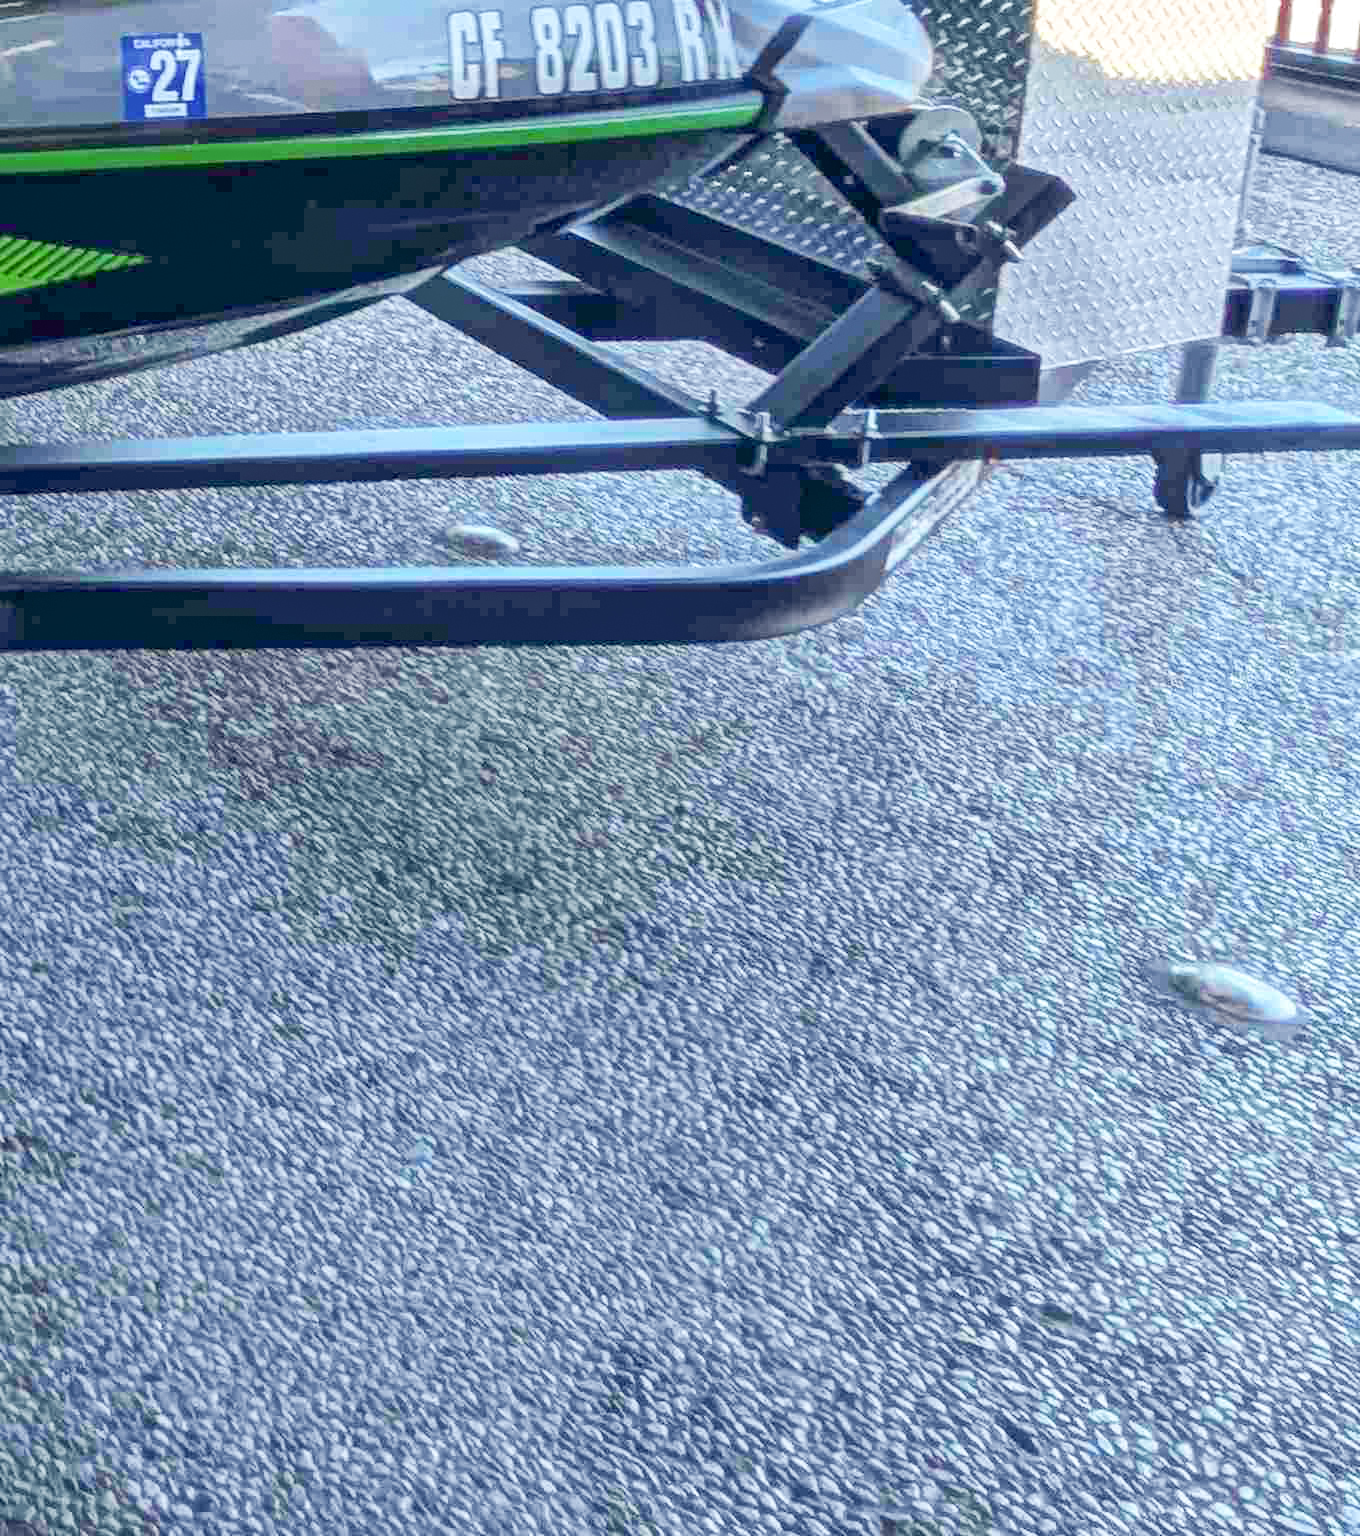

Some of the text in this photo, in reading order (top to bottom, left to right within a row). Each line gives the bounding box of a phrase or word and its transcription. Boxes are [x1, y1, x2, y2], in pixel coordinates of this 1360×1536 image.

[150, 48, 201, 102] 27
[448, 10, 505, 100] CF
[530, 0, 658, 95] 8203
